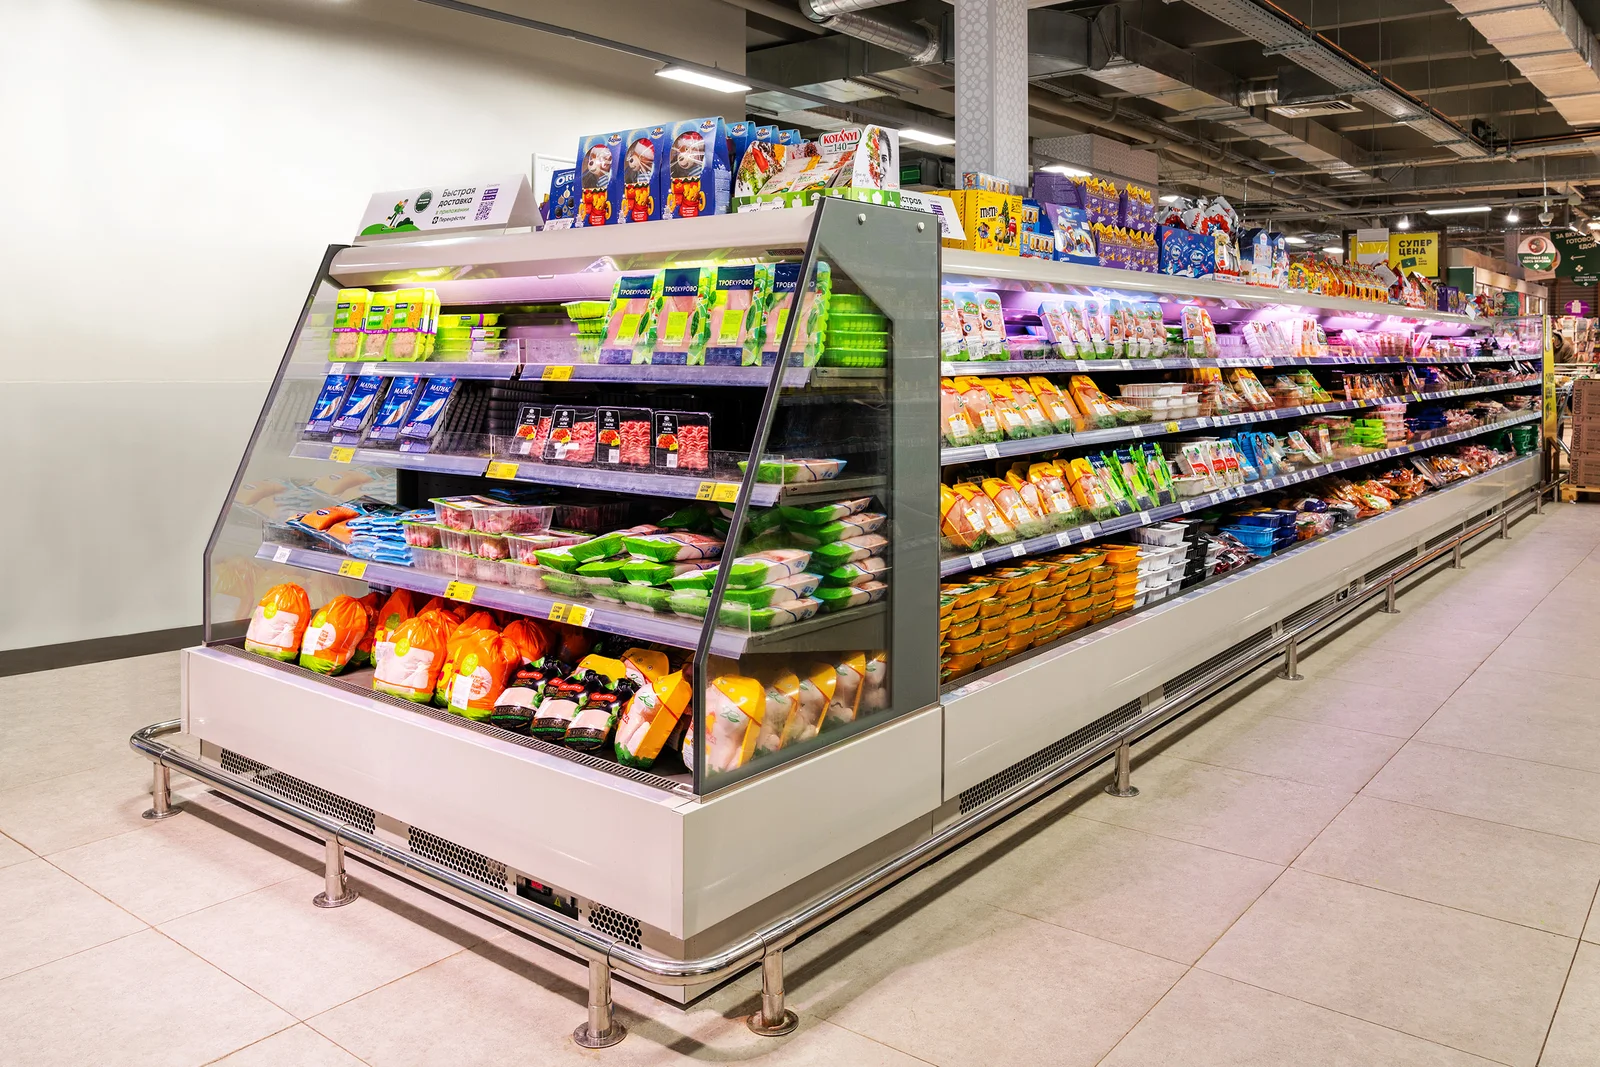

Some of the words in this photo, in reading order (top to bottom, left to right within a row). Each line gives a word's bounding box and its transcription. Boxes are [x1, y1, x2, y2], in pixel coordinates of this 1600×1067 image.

[823, 128, 857, 145] KOTÁNYI
[833, 142, 847, 152] 140
[442, 187, 477, 198] Быстрая
[437, 197, 473, 208] доставка
[1398, 239, 1433, 248] СУПЕР
[1398, 247, 1427, 257] ЦЕНА
[718, 278, 754, 287] ТРОЕКУРОВО
[619, 288, 652, 296] ТРОЕКУРОВО
[664, 285, 698, 293] ТРОЕКУРОВО
[1573, 388, 1582, 415] СЛОБОДА
[1573, 423, 1581, 450] СЛОБОДА
[1571, 458, 1579, 485] СЛОБОДА
